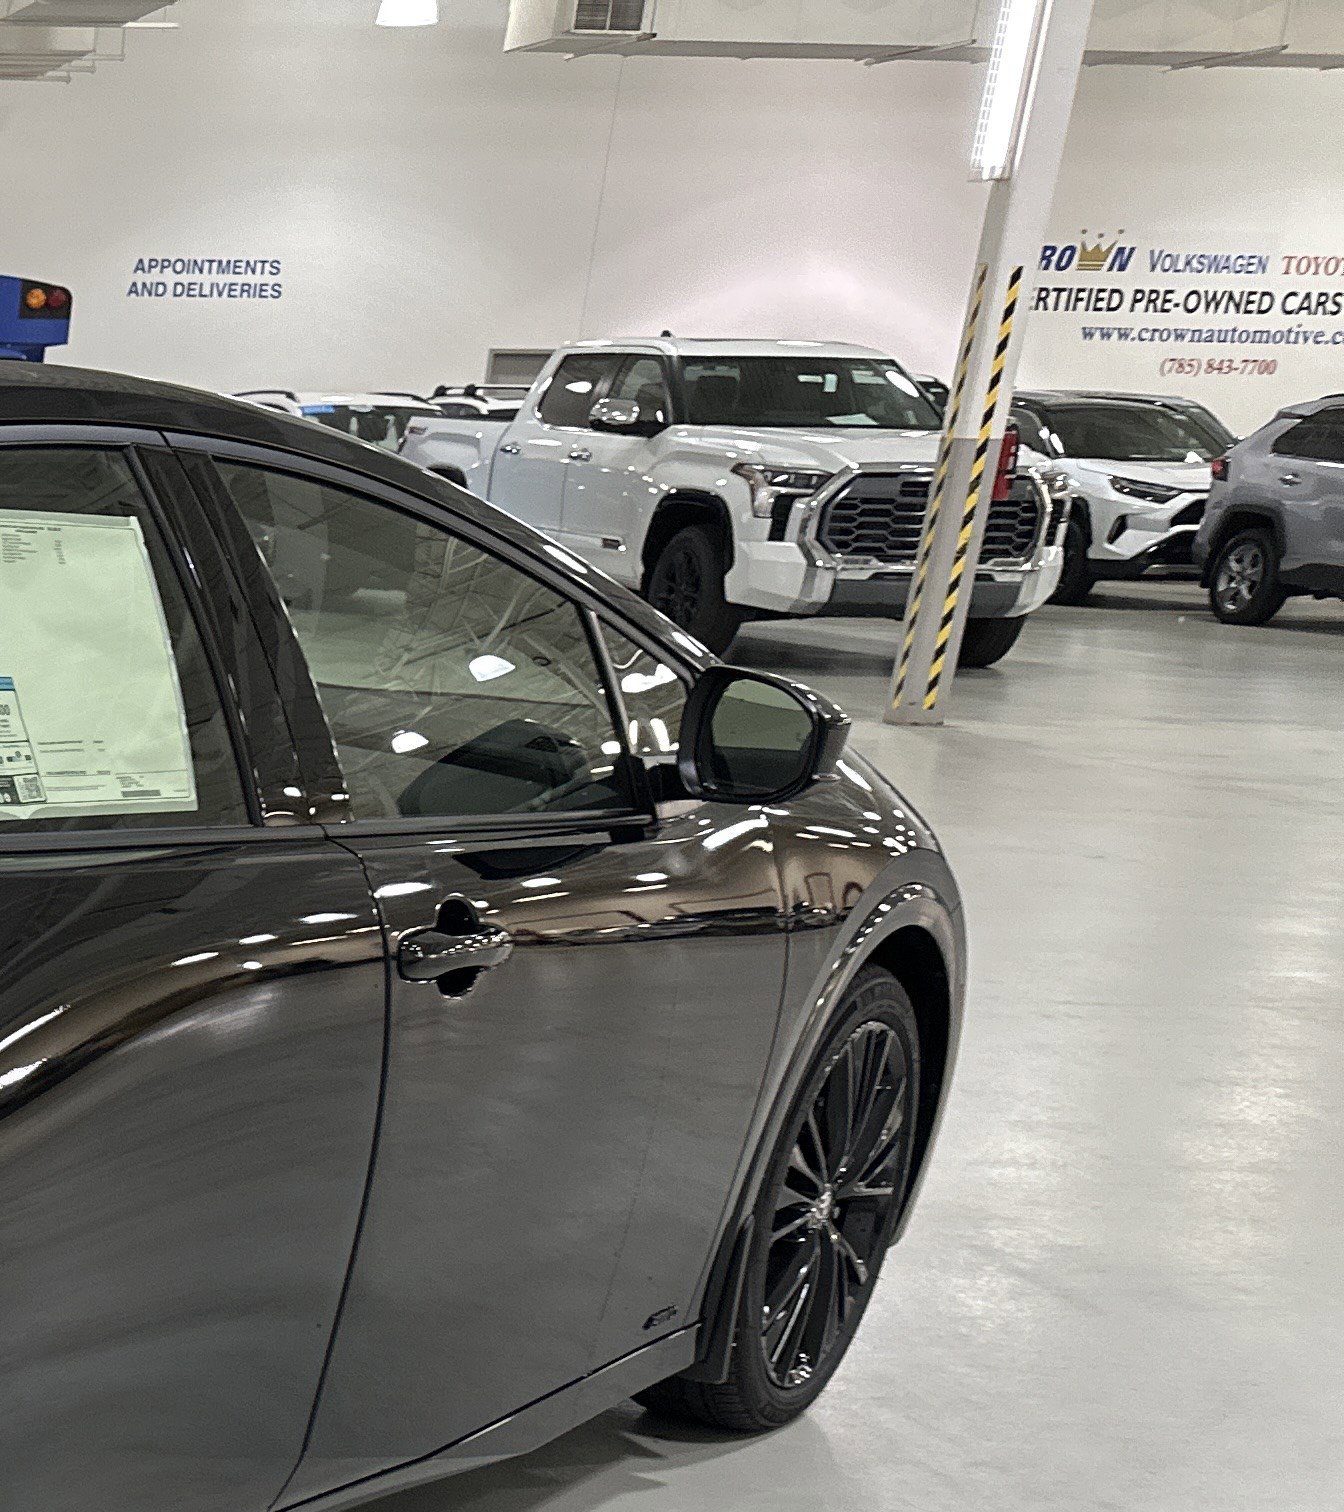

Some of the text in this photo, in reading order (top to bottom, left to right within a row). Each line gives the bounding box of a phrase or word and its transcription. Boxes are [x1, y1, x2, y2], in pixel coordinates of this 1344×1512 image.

[1036, 230, 1137, 273] ROWN
[1148, 248, 1270, 275] VOLKSWAGEN
[132, 257, 282, 276] APPOINTMENTS
[126, 281, 283, 299] AND DELIVERIES
[1128, 288, 1276, 317] PRE-OWNED
[1280, 290, 1344, 318] CARS
[1081, 322, 1344, 346] www.crownautomotive.c
[1158, 356, 1279, 378] (785) 843-7700
